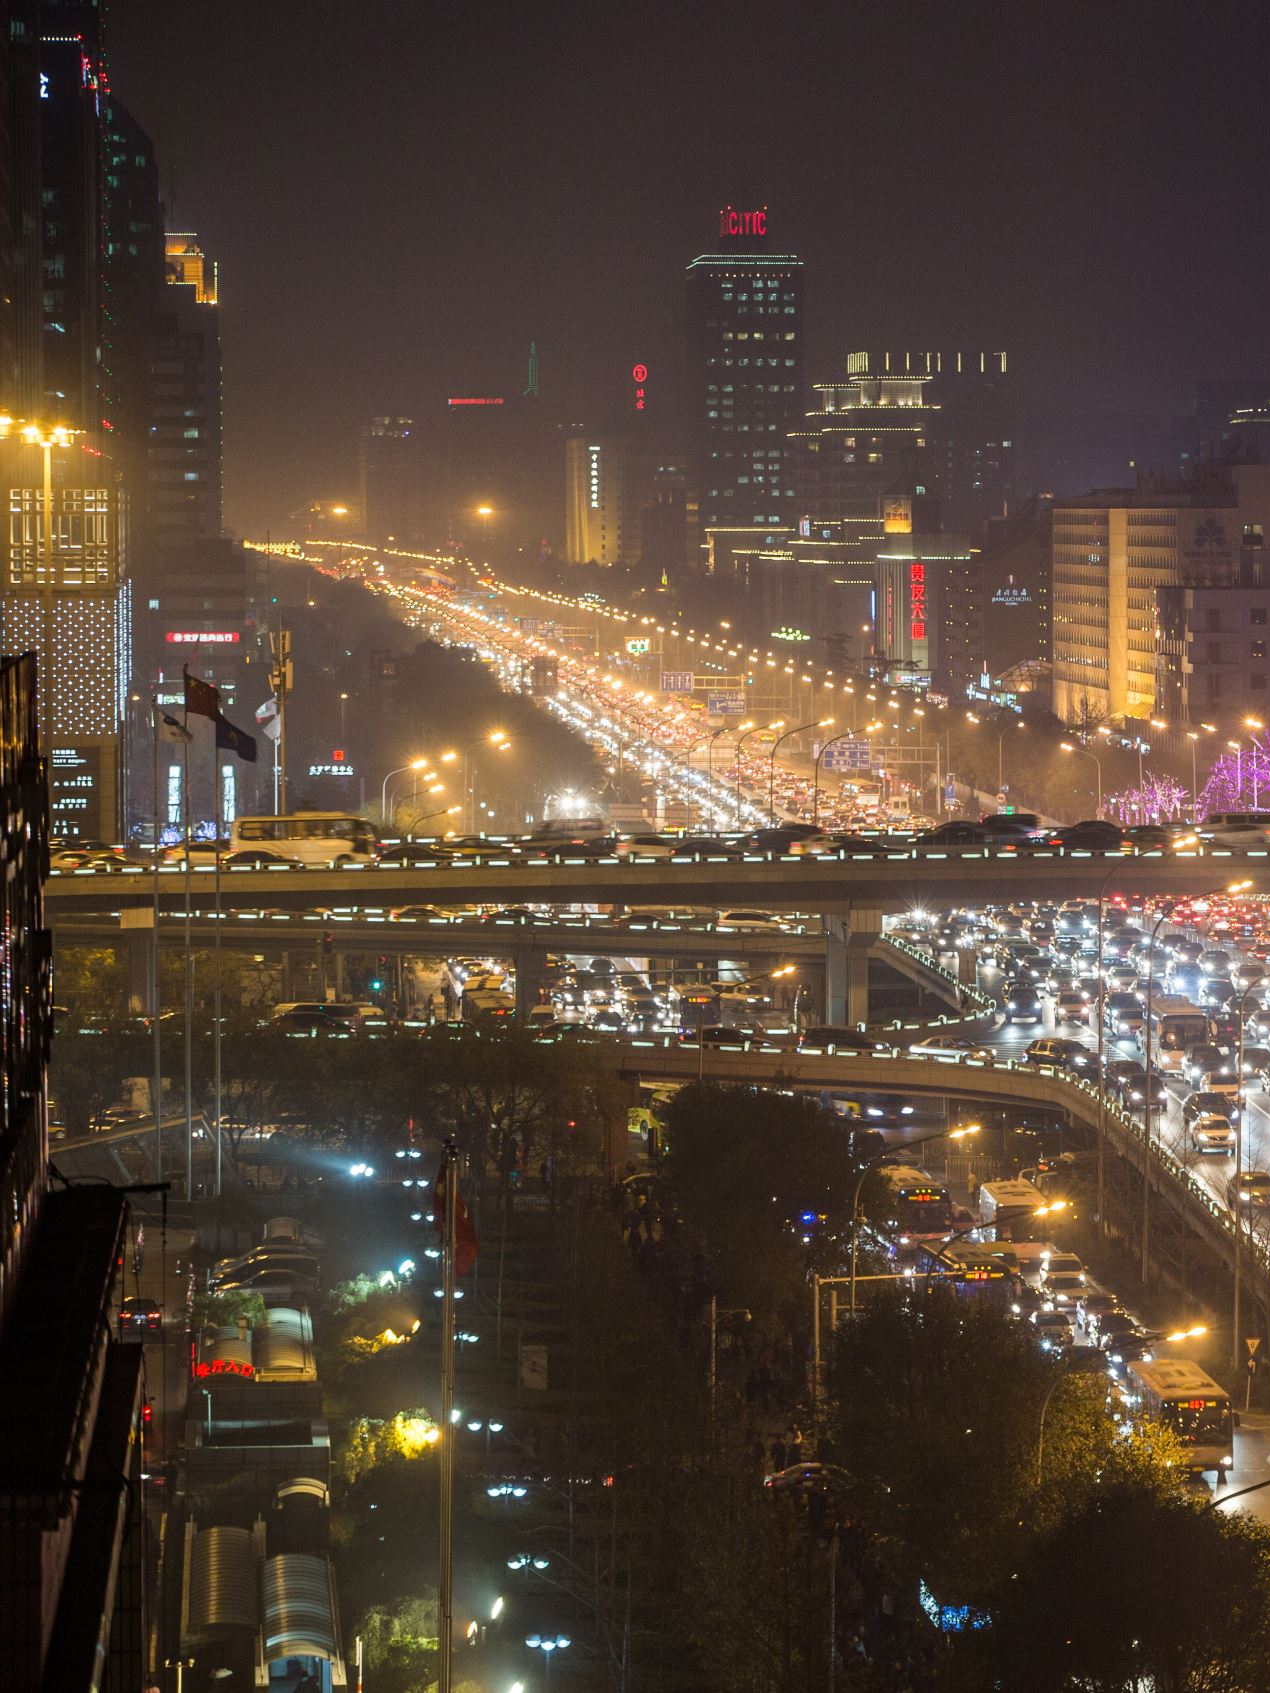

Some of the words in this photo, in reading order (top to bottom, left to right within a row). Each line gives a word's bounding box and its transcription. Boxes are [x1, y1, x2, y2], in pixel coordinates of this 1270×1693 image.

[729, 211, 767, 236] CITIC
[910, 564, 925, 641] 贵友大厦
